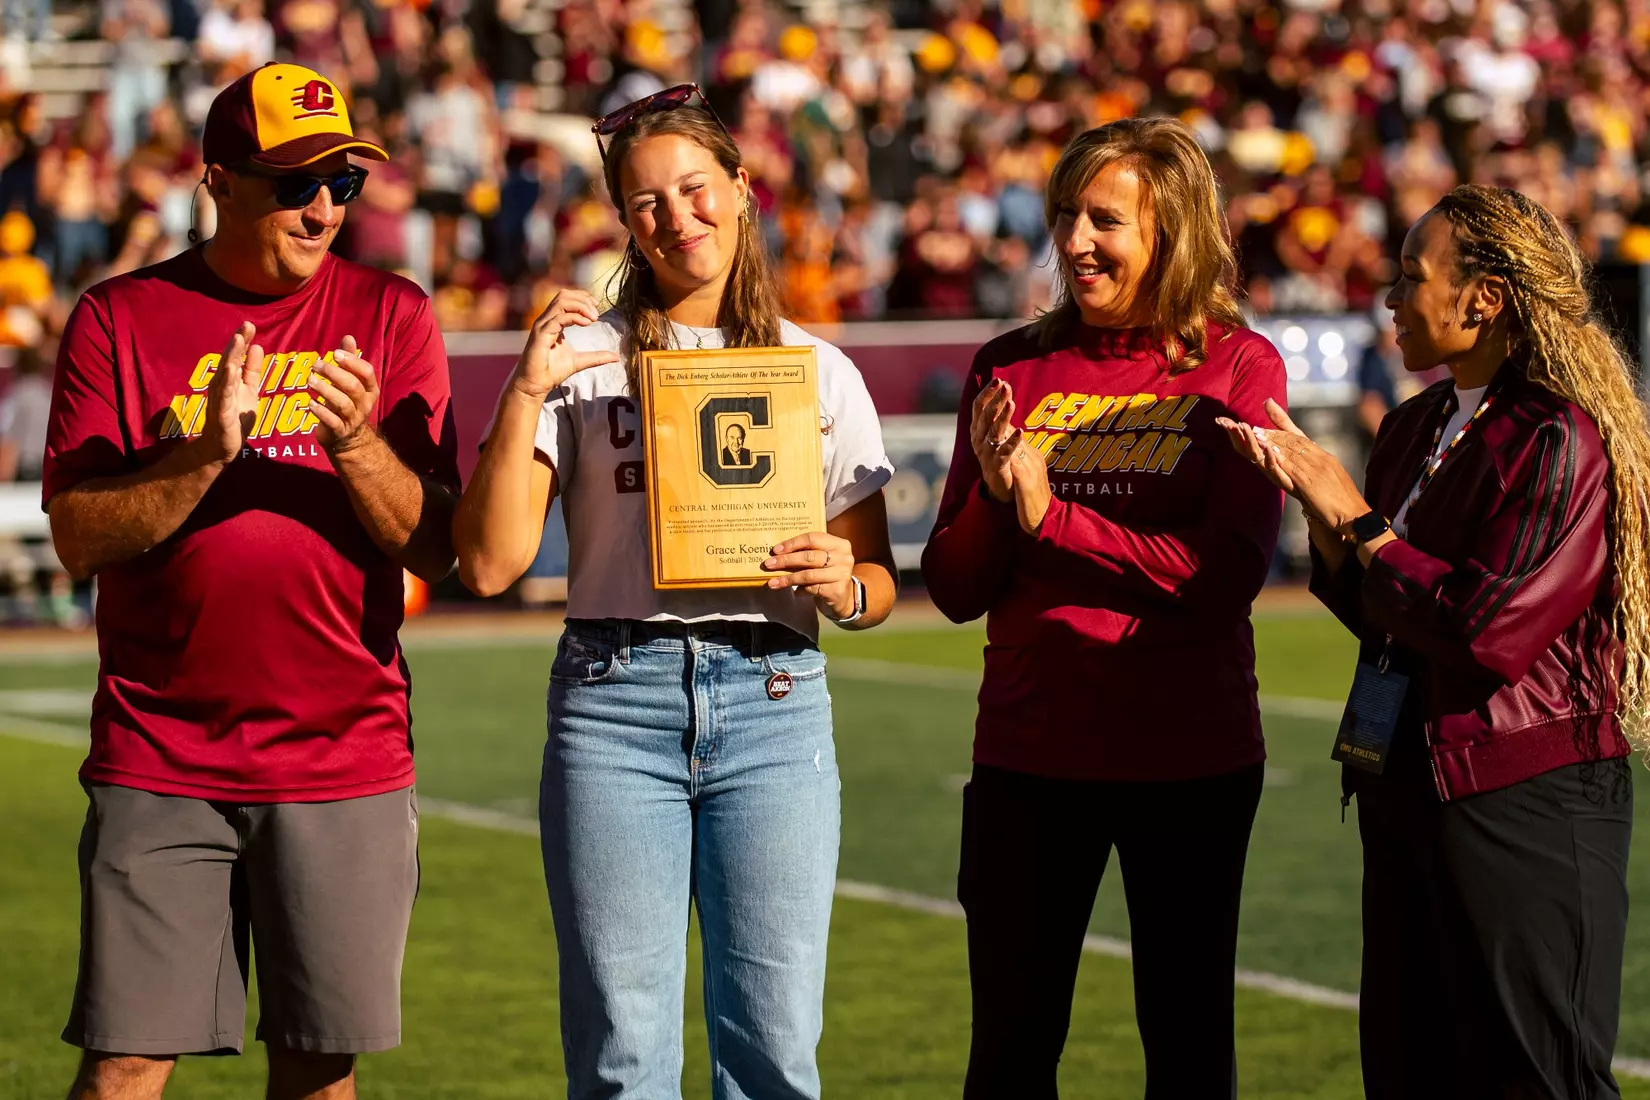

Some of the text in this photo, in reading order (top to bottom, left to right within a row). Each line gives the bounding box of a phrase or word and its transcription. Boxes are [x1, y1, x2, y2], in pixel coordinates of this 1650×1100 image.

[690, 372, 709, 381] Enberg
[750, 371, 757, 379] Of
[770, 370, 782, 378] Year
[1024, 392, 1200, 432] CENTRAL
[694, 391, 776, 489] C
[242, 444, 318, 459] FTBALL
[1049, 482, 1134, 495] OFTBALL
[669, 501, 807, 513] CENTRAL MICHIGAN UNIVERSITY
[706, 544, 736, 556] Grace
[719, 556, 743, 564] Softball
[1352, 746, 1381, 762] ATHLETICS
